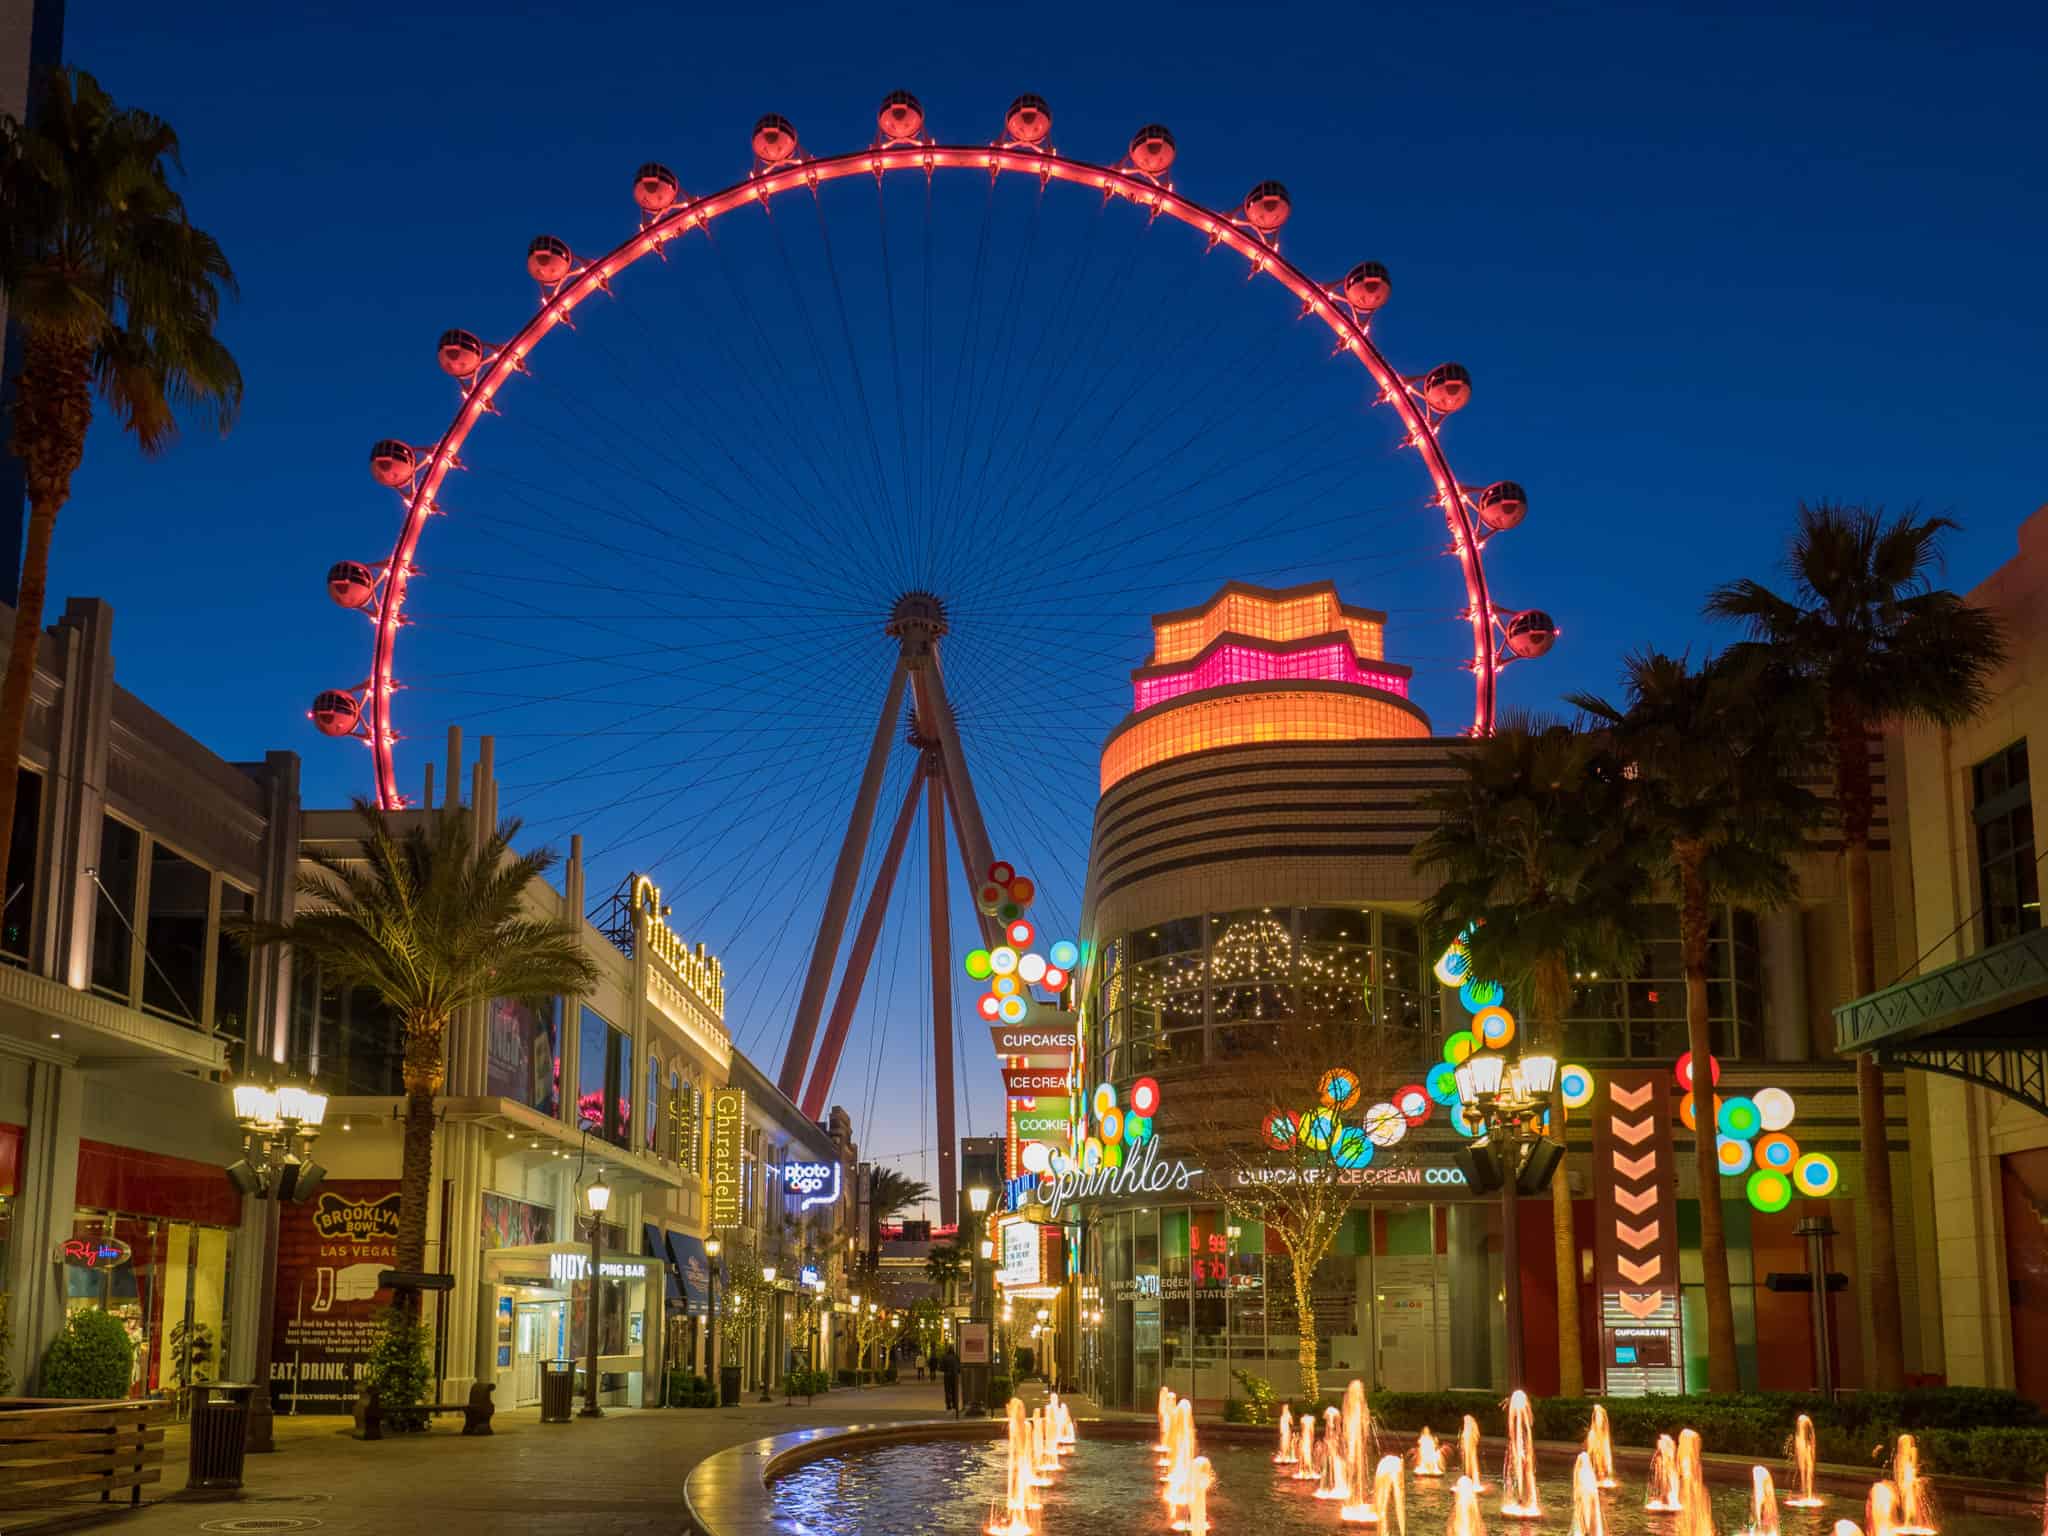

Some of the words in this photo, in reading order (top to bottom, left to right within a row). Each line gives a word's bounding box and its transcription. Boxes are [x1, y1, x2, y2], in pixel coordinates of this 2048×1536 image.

[1003, 1034, 1076, 1047] CUPCAKES
[1010, 1077, 1030, 1088] ICE
[1020, 1119, 1068, 1131] COOKIE
[714, 1096, 738, 1219] Ghirardelli
[785, 1162, 830, 1180] photo
[1037, 1134, 1204, 1218] Sprinkles
[1425, 1168, 1467, 1184] COO
[321, 1207, 399, 1228] BROOKLYN
[346, 1221, 381, 1232] BOWL
[321, 1245, 347, 1256] LAS
[625, 1264, 646, 1277] BAR
[302, 1362, 349, 1380] DRINK.
